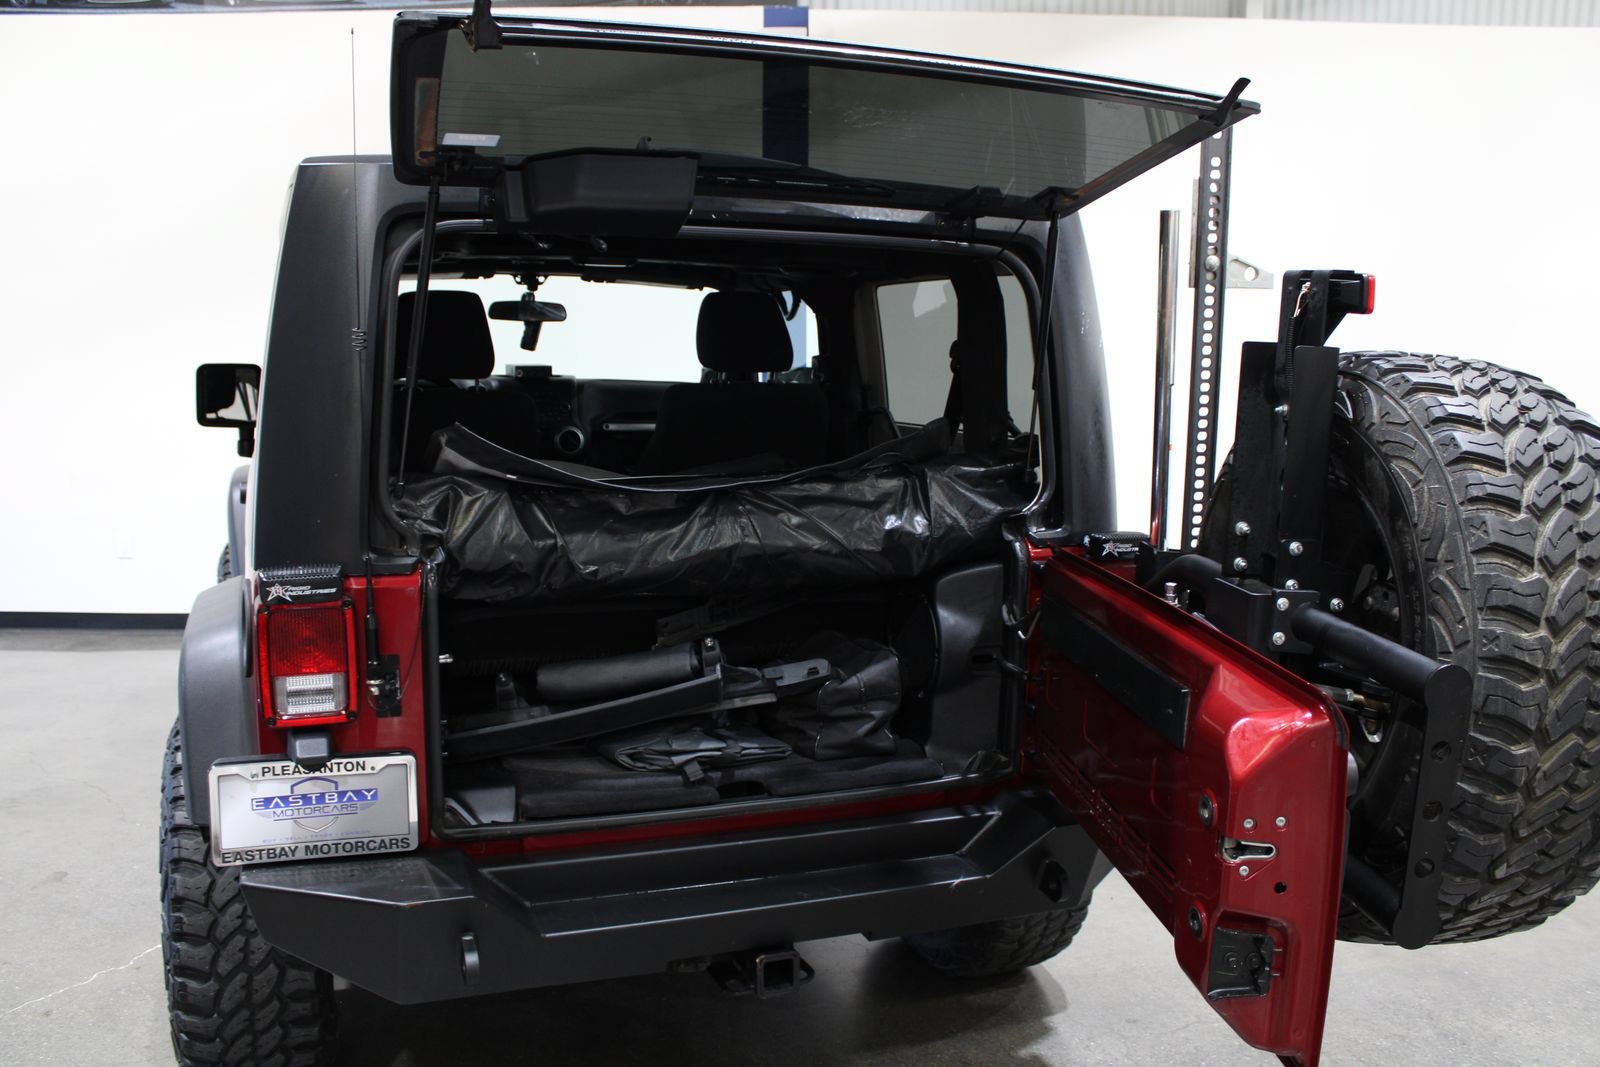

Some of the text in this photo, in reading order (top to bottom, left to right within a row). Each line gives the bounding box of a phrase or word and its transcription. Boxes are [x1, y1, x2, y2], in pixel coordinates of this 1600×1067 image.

[252, 788, 378, 810] EASTBAY
[272, 802, 359, 818] MOTORCARS
[221, 837, 411, 864] EASTBAY MOTORCARS
